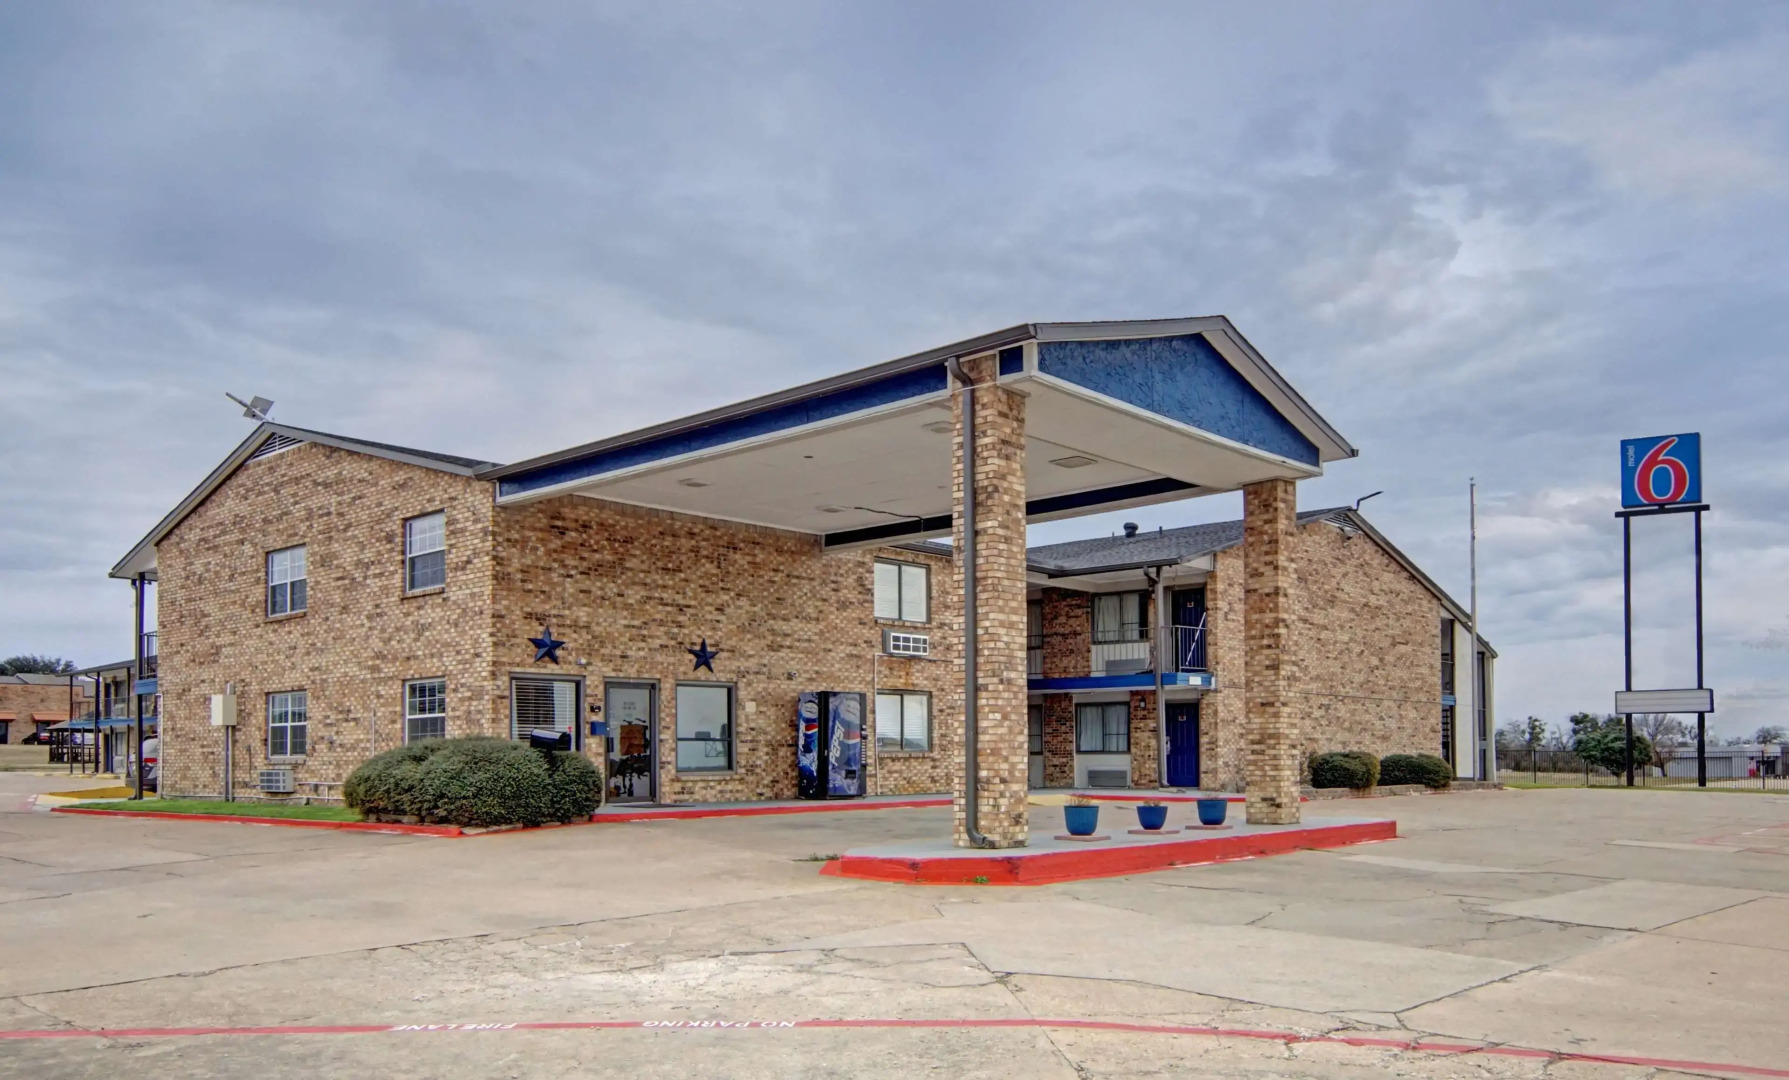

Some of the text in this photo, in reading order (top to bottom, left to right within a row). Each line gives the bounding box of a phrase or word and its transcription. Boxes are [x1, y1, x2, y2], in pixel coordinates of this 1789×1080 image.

[1634, 436, 1689, 504] 6
[829, 720, 845, 766] PEPSI
[642, 1020, 796, 1028] NO PARKING
